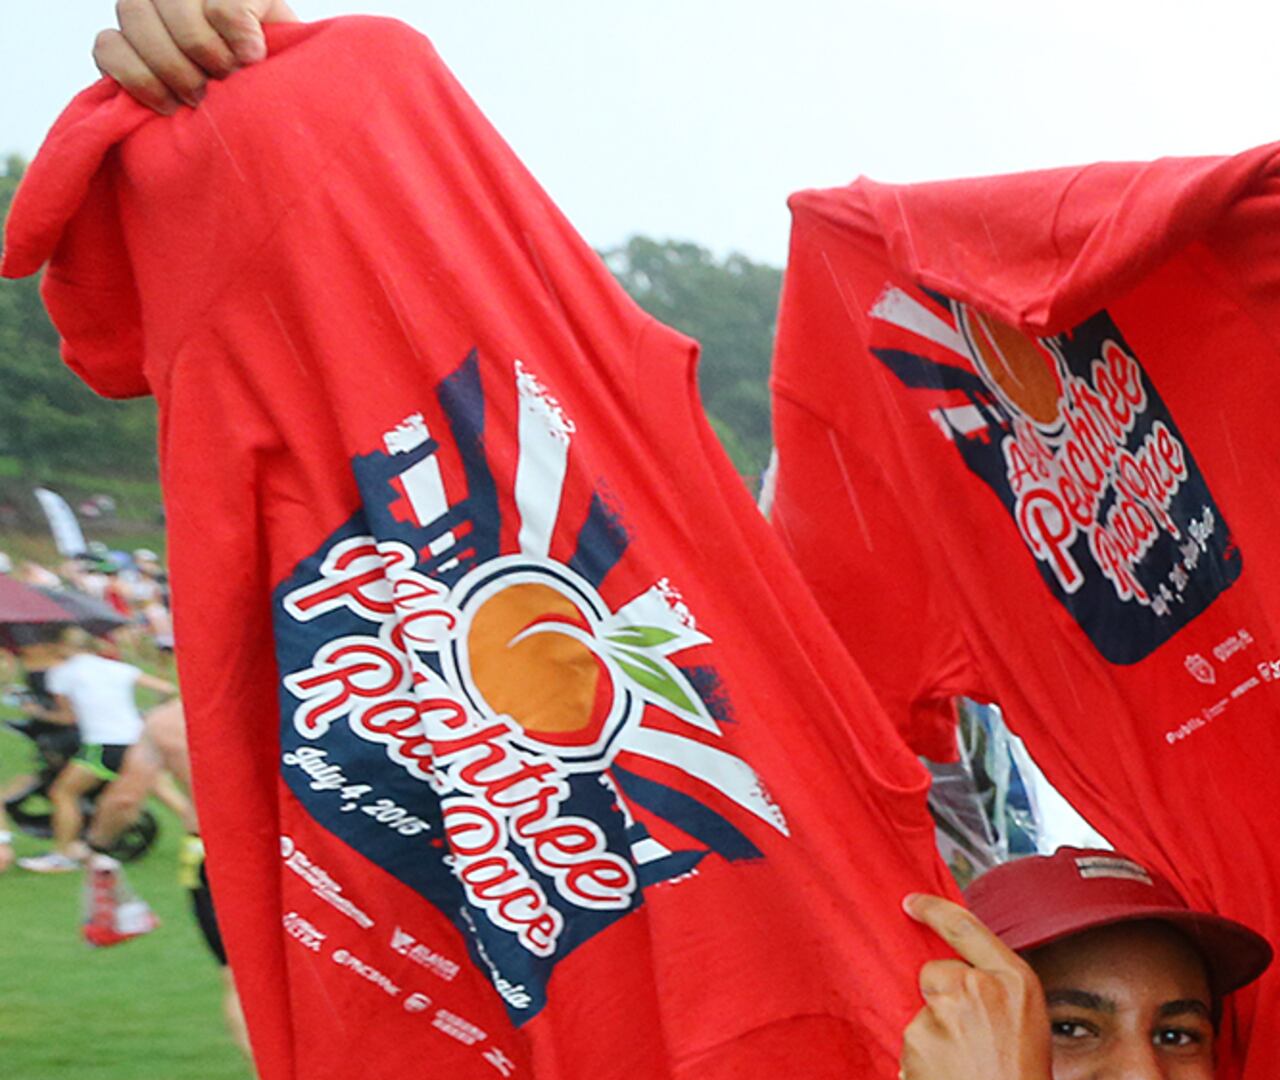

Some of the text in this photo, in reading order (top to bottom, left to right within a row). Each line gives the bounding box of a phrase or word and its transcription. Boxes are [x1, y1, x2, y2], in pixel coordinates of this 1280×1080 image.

[1018, 343, 1145, 588] Peachtree
[282, 746, 347, 791] July
[360, 798, 432, 836] 2015
